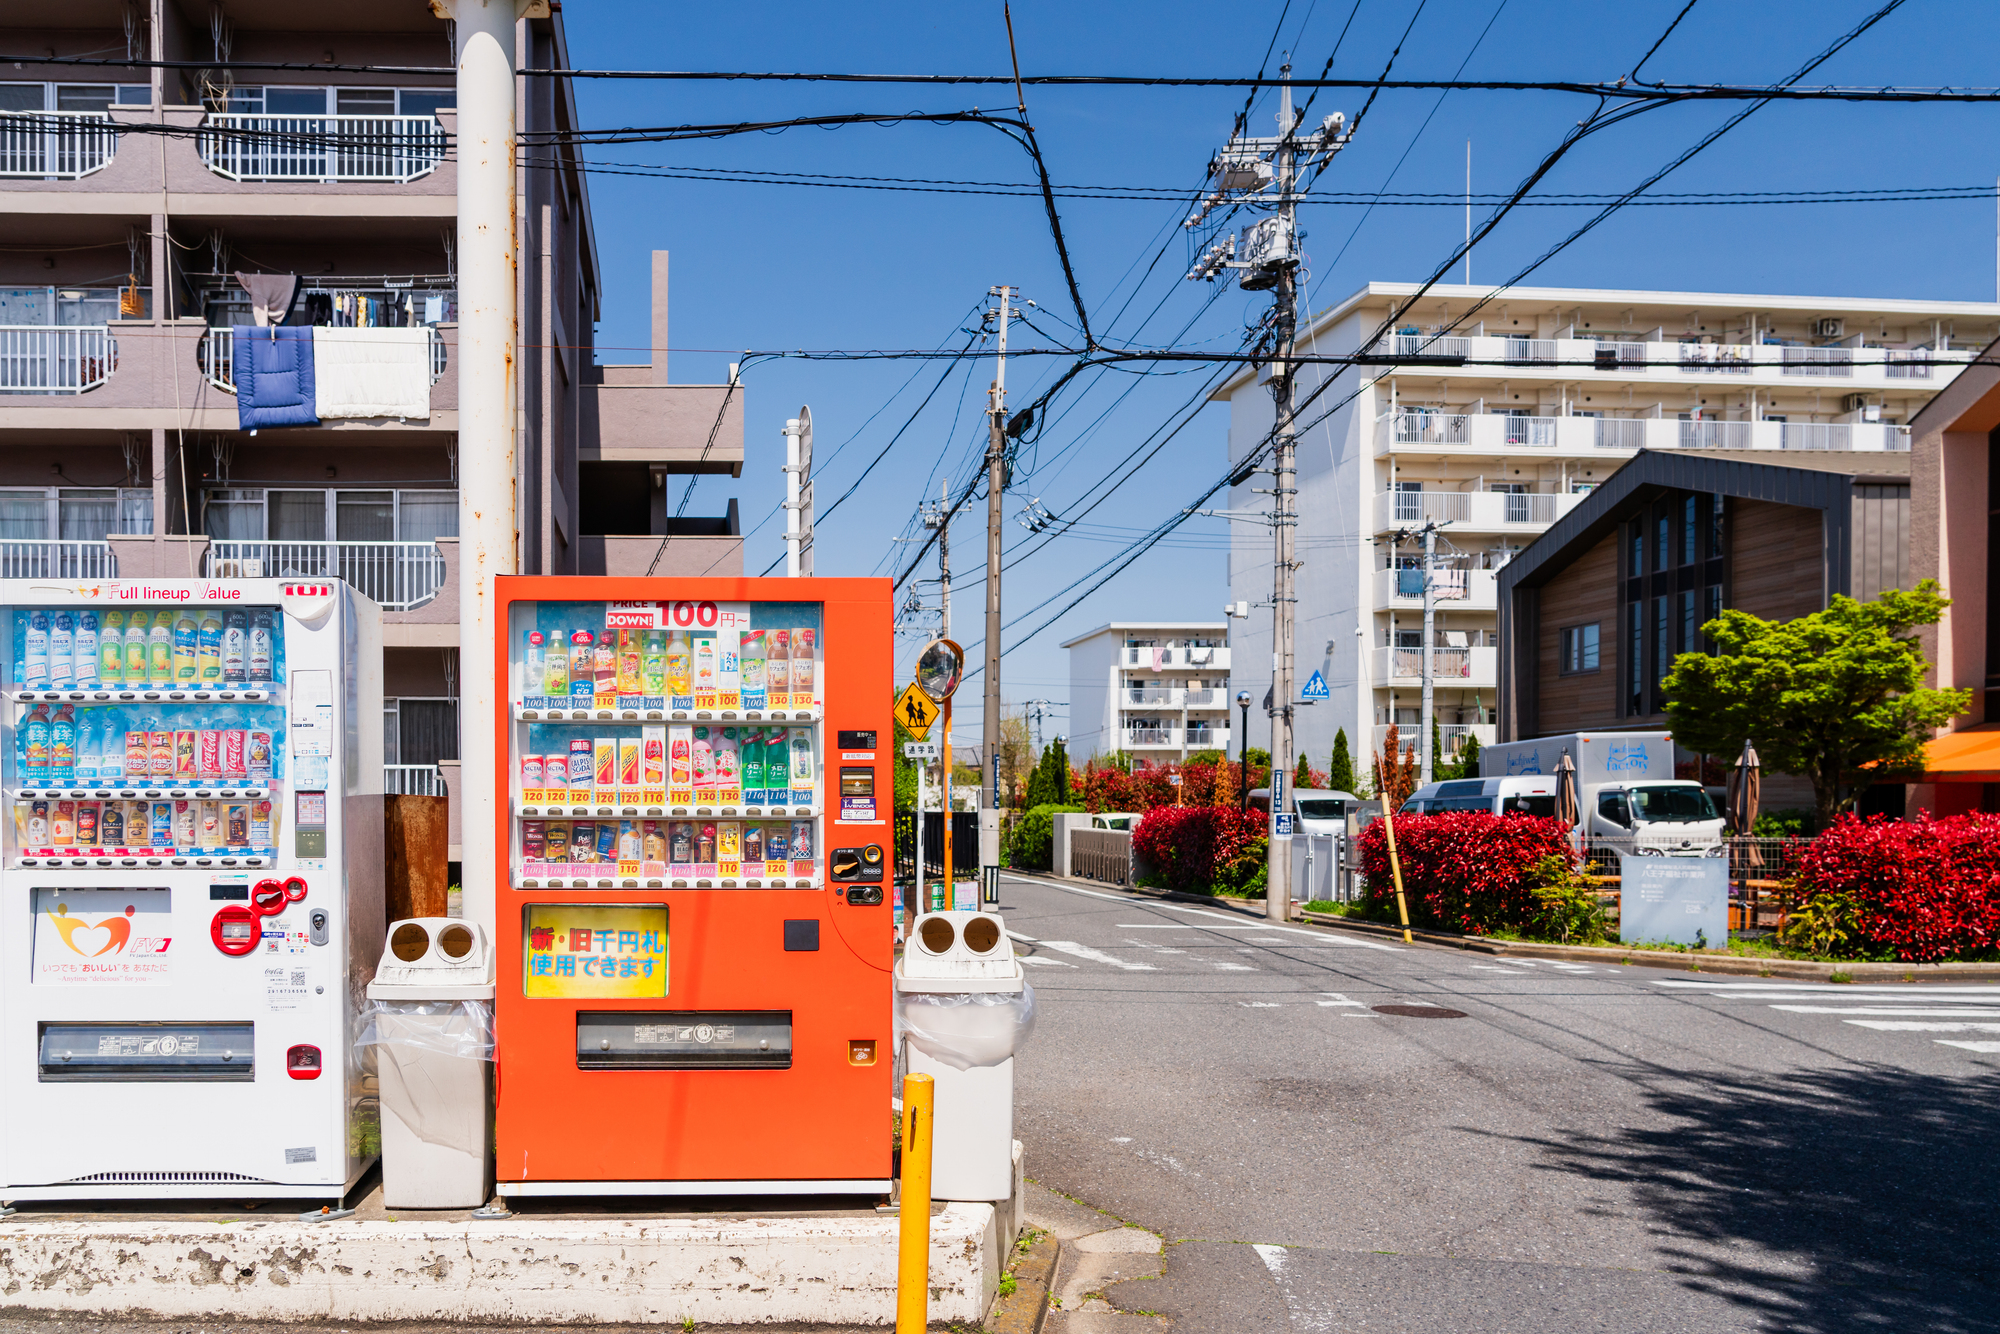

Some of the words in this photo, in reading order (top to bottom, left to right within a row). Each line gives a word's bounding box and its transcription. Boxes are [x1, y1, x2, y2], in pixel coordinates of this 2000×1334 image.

[108, 582, 138, 599] Full
[143, 586, 191, 602] lineup
[194, 582, 241, 600] Value
[607, 615, 653, 627] DOWN!
[525, 699, 541, 707] 100
[549, 699, 565, 707] 100
[574, 699, 589, 707] 100
[596, 698, 614, 706] 110
[621, 699, 638, 707] 100
[645, 699, 662, 707] 100
[674, 699, 690, 707] 100
[696, 698, 714, 707] 110
[719, 696, 737, 705] 100
[746, 699, 761, 707] 100
[770, 696, 787, 704] 130
[794, 696, 812, 704] 130
[27, 729, 47, 741] 麦茶
[52, 729, 73, 741] 麦茶
[908, 745, 935, 755] 通学路
[572, 765, 591, 774] SODA
[1607, 758, 1649, 774] factory
[524, 792, 543, 801] 120
[547, 792, 566, 801] 120
[571, 793, 589, 802] 120
[596, 794, 614, 803] 120
[621, 794, 639, 803] 120
[644, 794, 663, 803] 110
[671, 794, 690, 802] 110
[697, 792, 716, 801] 130
[721, 792, 739, 801] 130
[747, 791, 763, 799] 110
[769, 791, 786, 800] 110
[794, 793, 810, 801] 100
[620, 865, 638, 873] 110
[720, 865, 737, 873] 110
[767, 865, 785, 873] 120
[530, 926, 665, 954] 新・旧千円札
[129, 937, 172, 953] FVJ
[133, 963, 168, 973] あなたに
[530, 953, 660, 979] 使用できます
